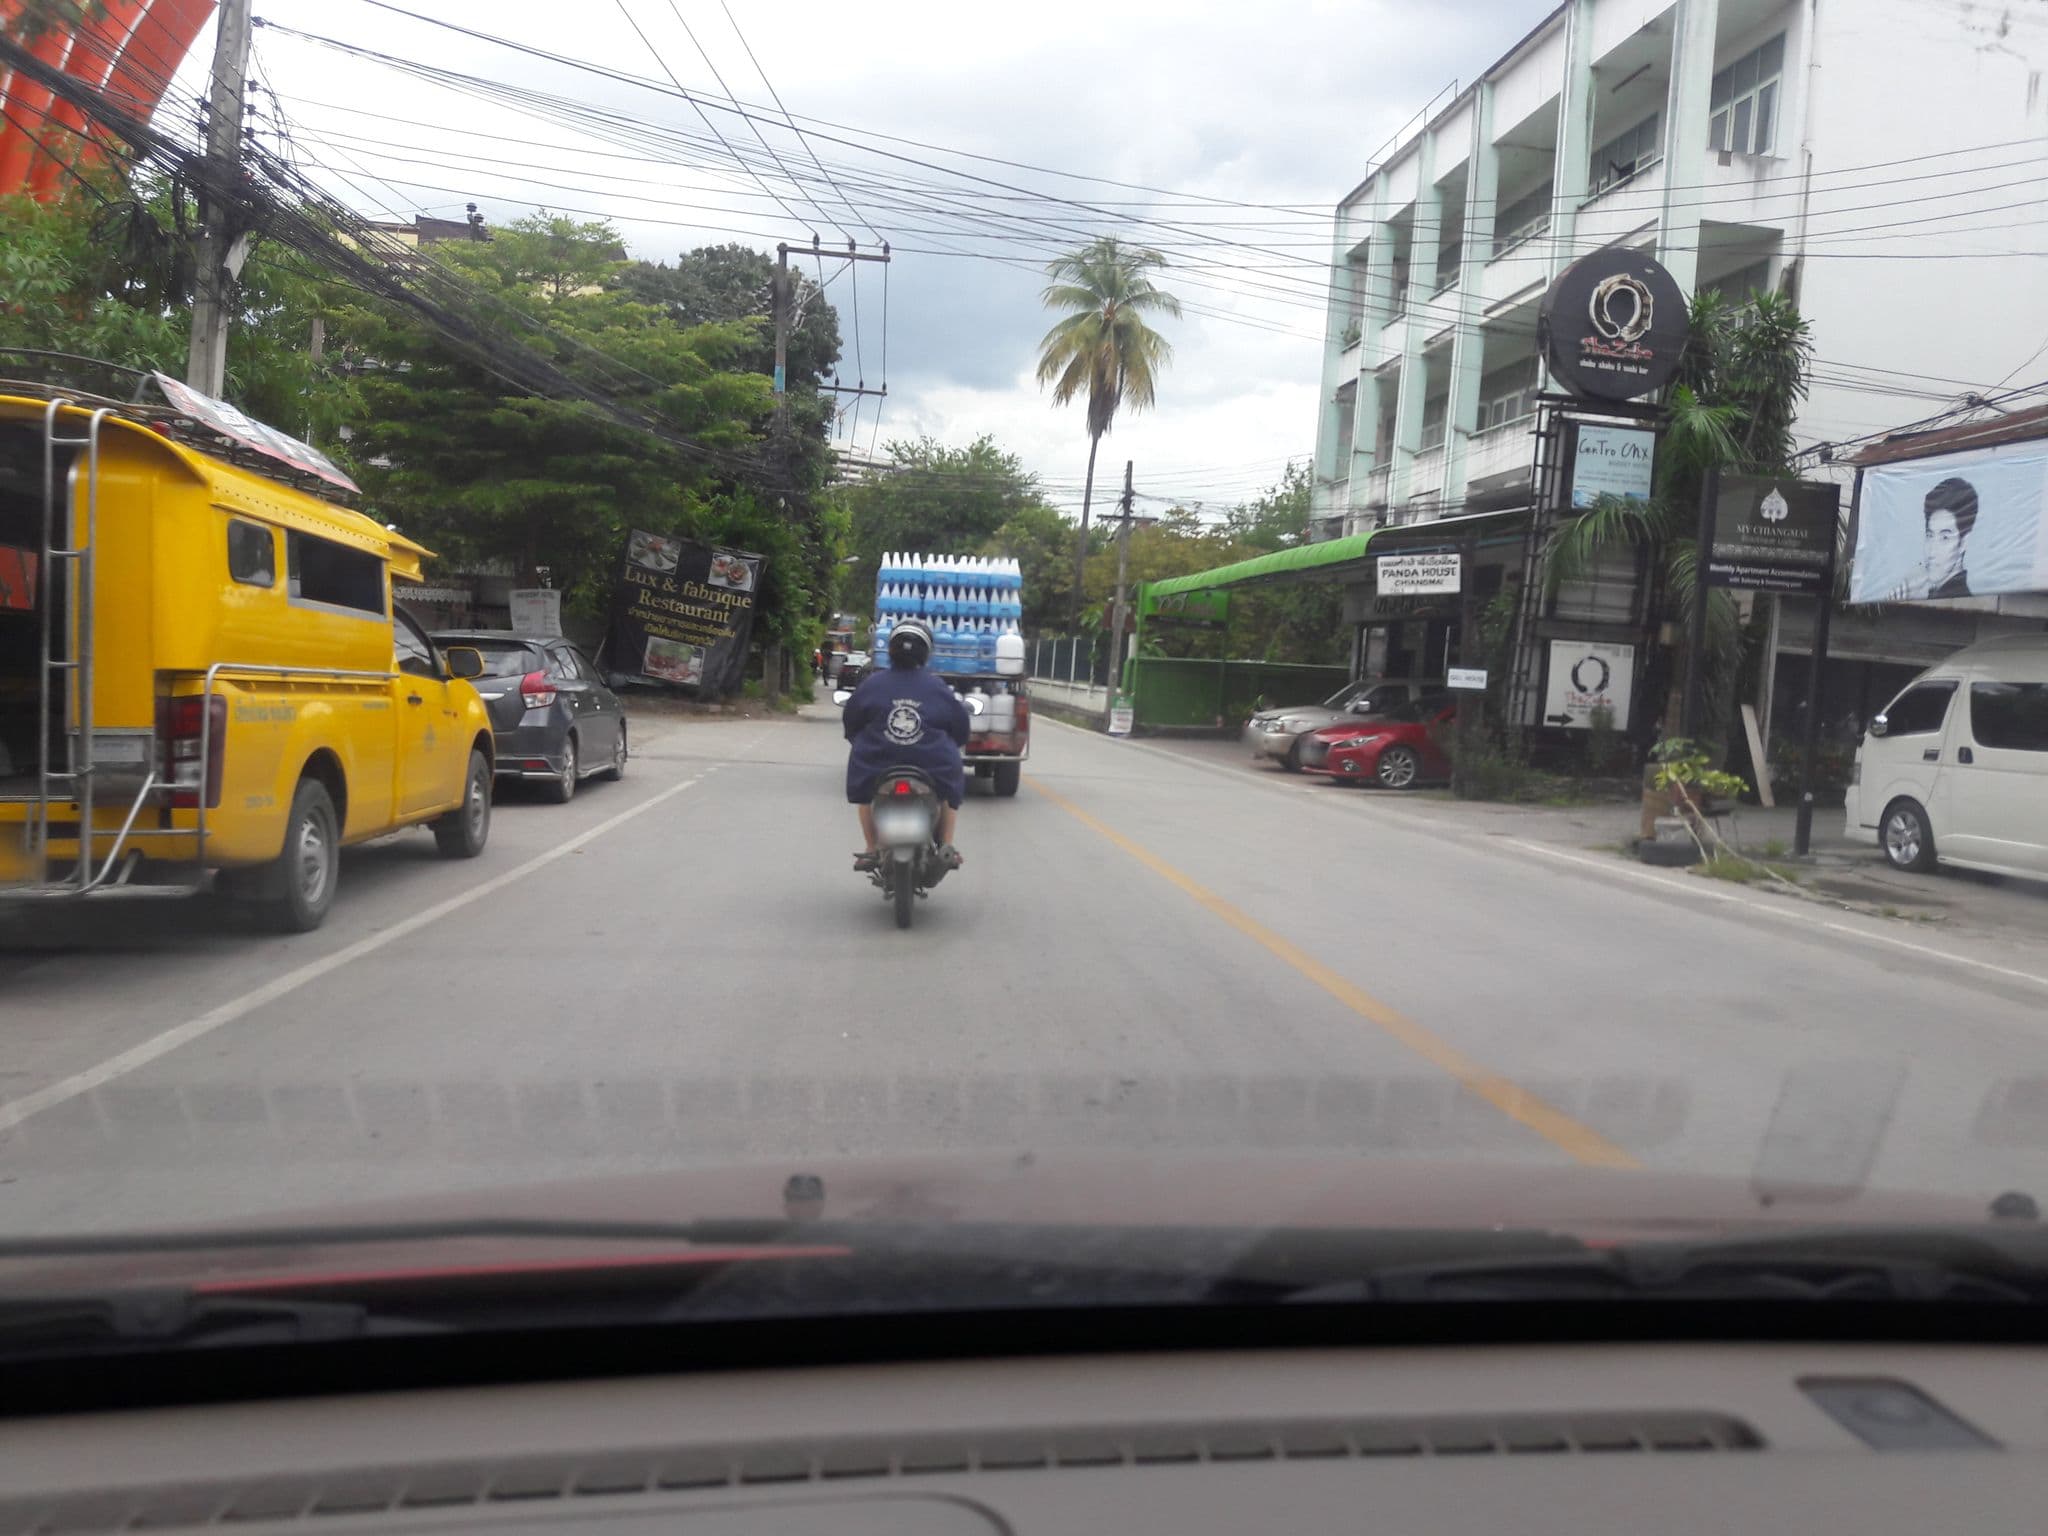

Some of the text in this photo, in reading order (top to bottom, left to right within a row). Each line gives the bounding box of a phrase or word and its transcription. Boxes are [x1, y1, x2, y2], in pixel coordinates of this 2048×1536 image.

[1737, 524, 1808, 538] MY CHIANGMAI
[1382, 566, 1457, 578] PANDA HOUSE
[1736, 566, 1770, 576] Apartment
[623, 564, 752, 609] Lux & fabrique
[1394, 578, 1444, 587] CHIANGMAI
[637, 588, 730, 623] Restaurant
